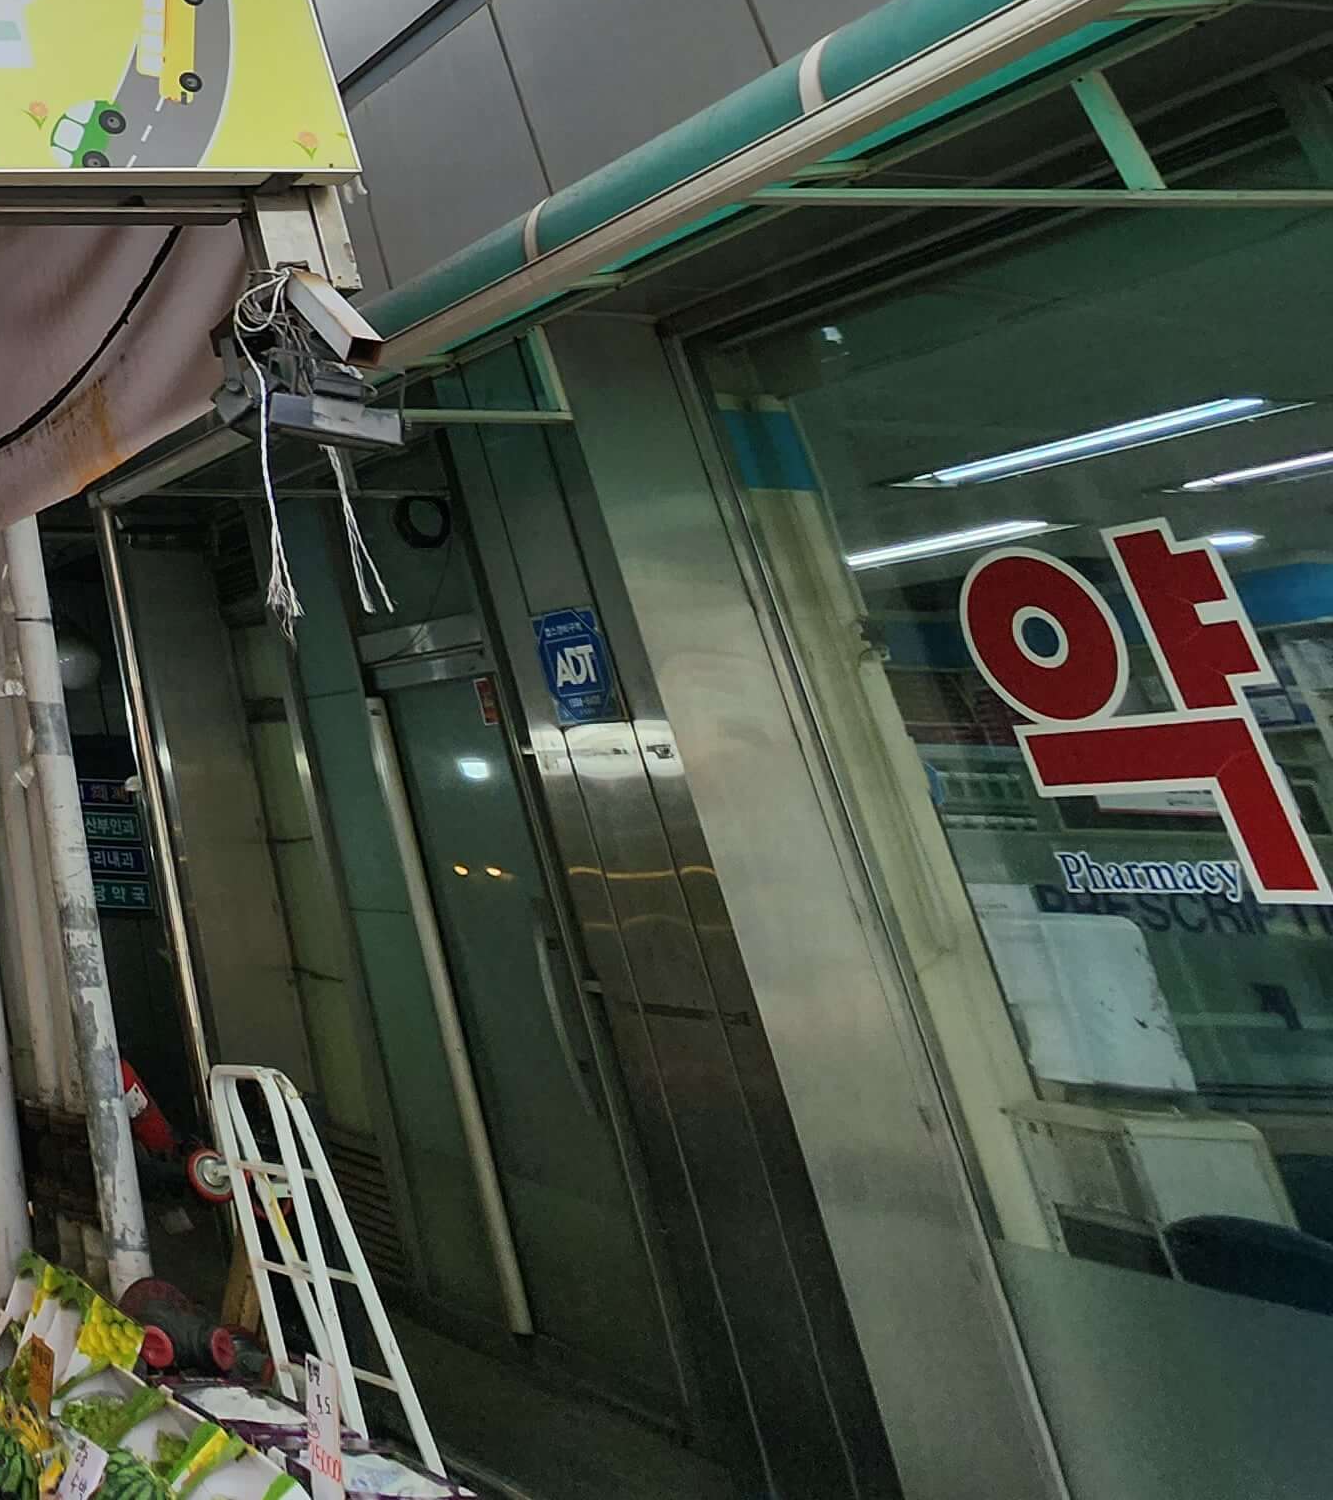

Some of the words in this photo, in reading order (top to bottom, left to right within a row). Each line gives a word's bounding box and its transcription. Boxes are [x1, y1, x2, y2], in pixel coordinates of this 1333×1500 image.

[555, 643, 598, 688] ADT
[959, 517, 1333, 906] 약
[84, 816, 135, 837] 산부인과
[90, 850, 135, 869] 리내과
[1055, 850, 1243, 902] Pharmacy
